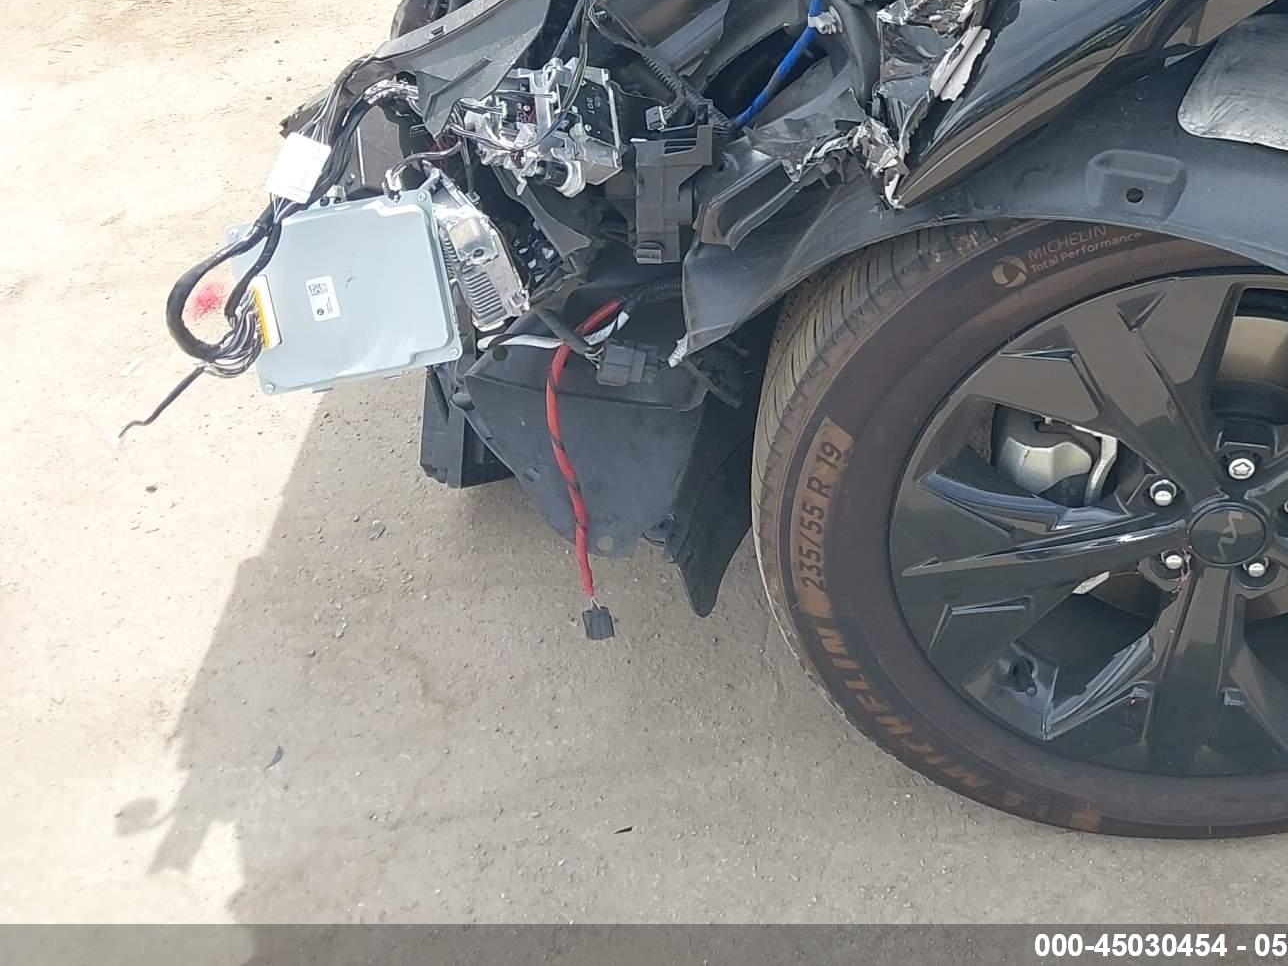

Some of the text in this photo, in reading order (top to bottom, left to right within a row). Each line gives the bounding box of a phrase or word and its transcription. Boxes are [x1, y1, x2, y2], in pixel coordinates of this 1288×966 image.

[1028, 225, 1107, 261] MICHELIN
[1031, 232, 1142, 274] Total Performance
[798, 441, 842, 592] 235/55 R 19
[816, 626, 990, 787] MICHELIN
